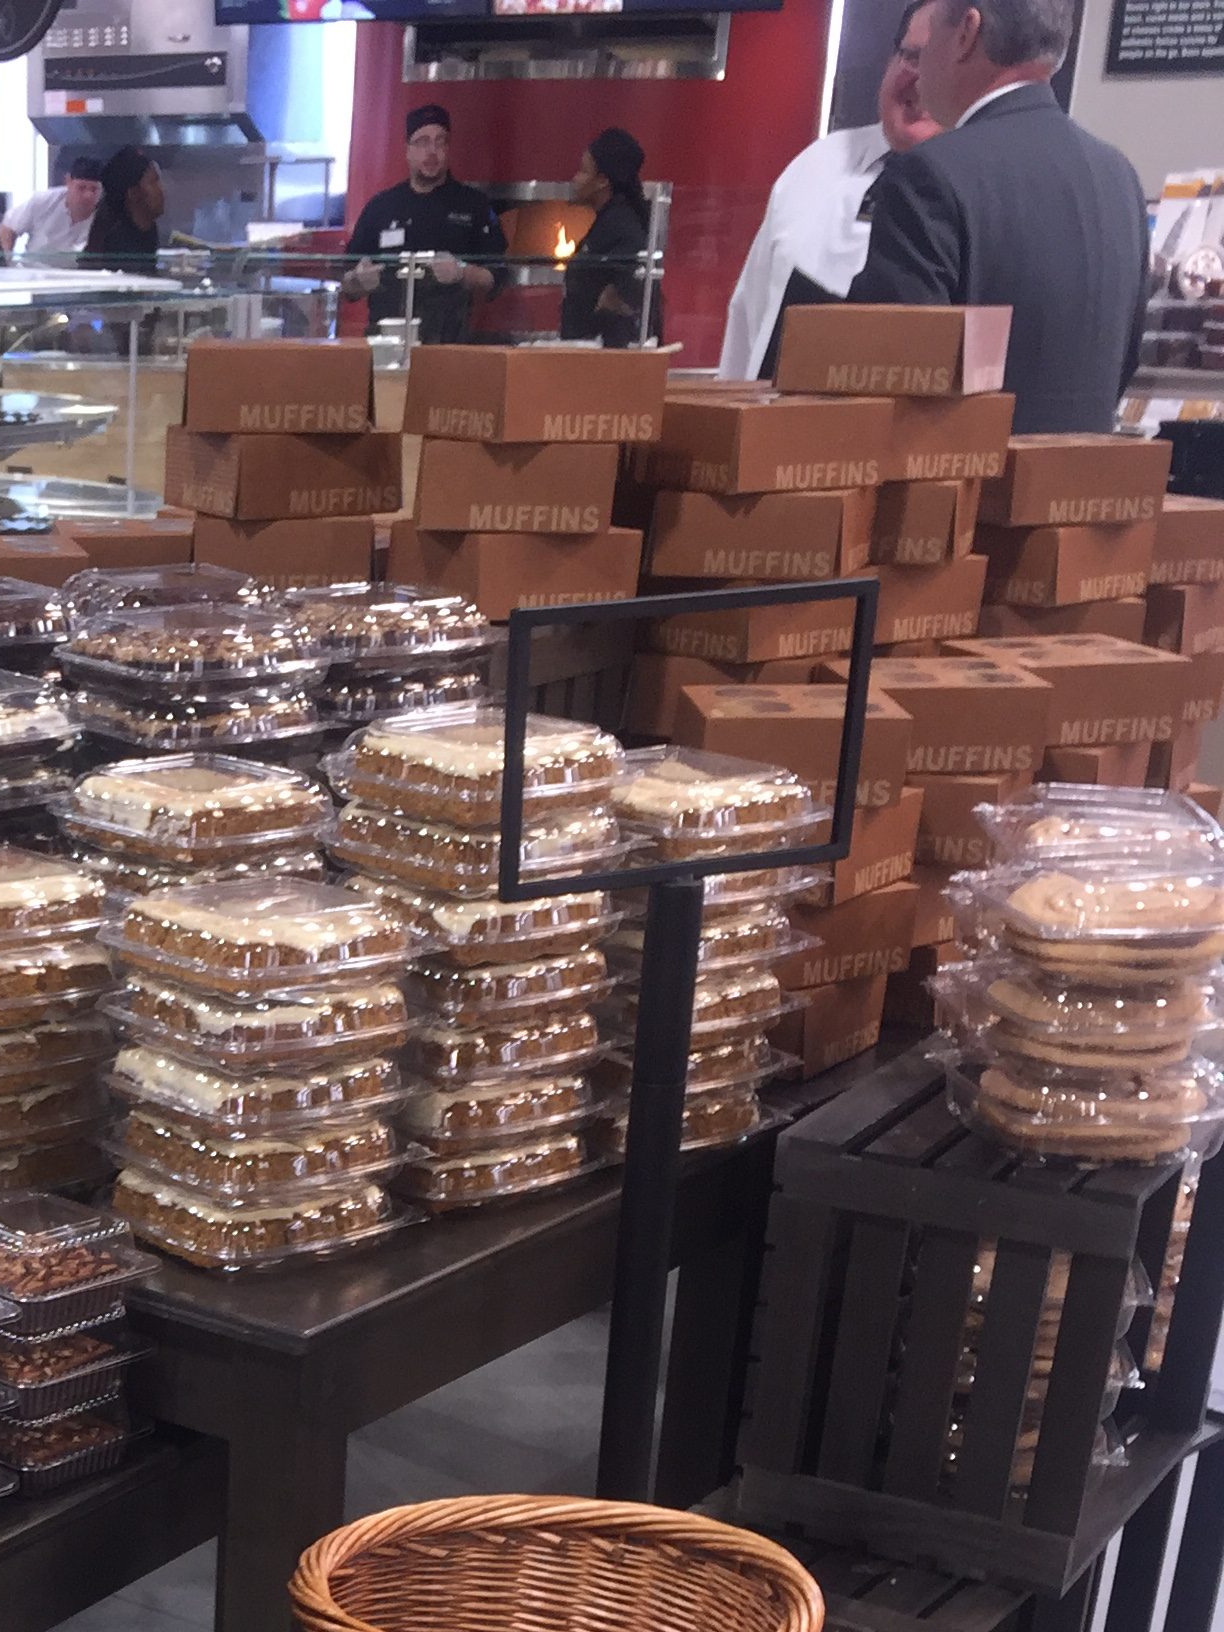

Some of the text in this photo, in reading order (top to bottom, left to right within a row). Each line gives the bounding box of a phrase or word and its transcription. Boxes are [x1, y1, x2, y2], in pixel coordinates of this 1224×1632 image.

[827, 364, 950, 392] MUFFINS
[240, 403, 366, 430] MUFFINS
[428, 406, 494, 438] MUFFINS
[543, 413, 653, 441] MUFFINS
[776, 459, 878, 490] MUFFINS
[906, 452, 1000, 478] MUFFINS
[289, 486, 399, 513] MUFFINS
[1049, 496, 1153, 523] MUFFINS
[469, 504, 600, 531] MUFFINS
[704, 550, 830, 577] MUFFINS
[1152, 558, 1224, 584] MUFFIN
[1080, 571, 1146, 601] MUFFINS
[894, 612, 974, 641] MUFFINS
[662, 625, 738, 660] UFFINS
[779, 627, 852, 656] MUFFIN
[1060, 715, 1173, 745] MUFFINS
[854, 851, 912, 894] MUFFINS
[803, 945, 903, 986] MUFFINS
